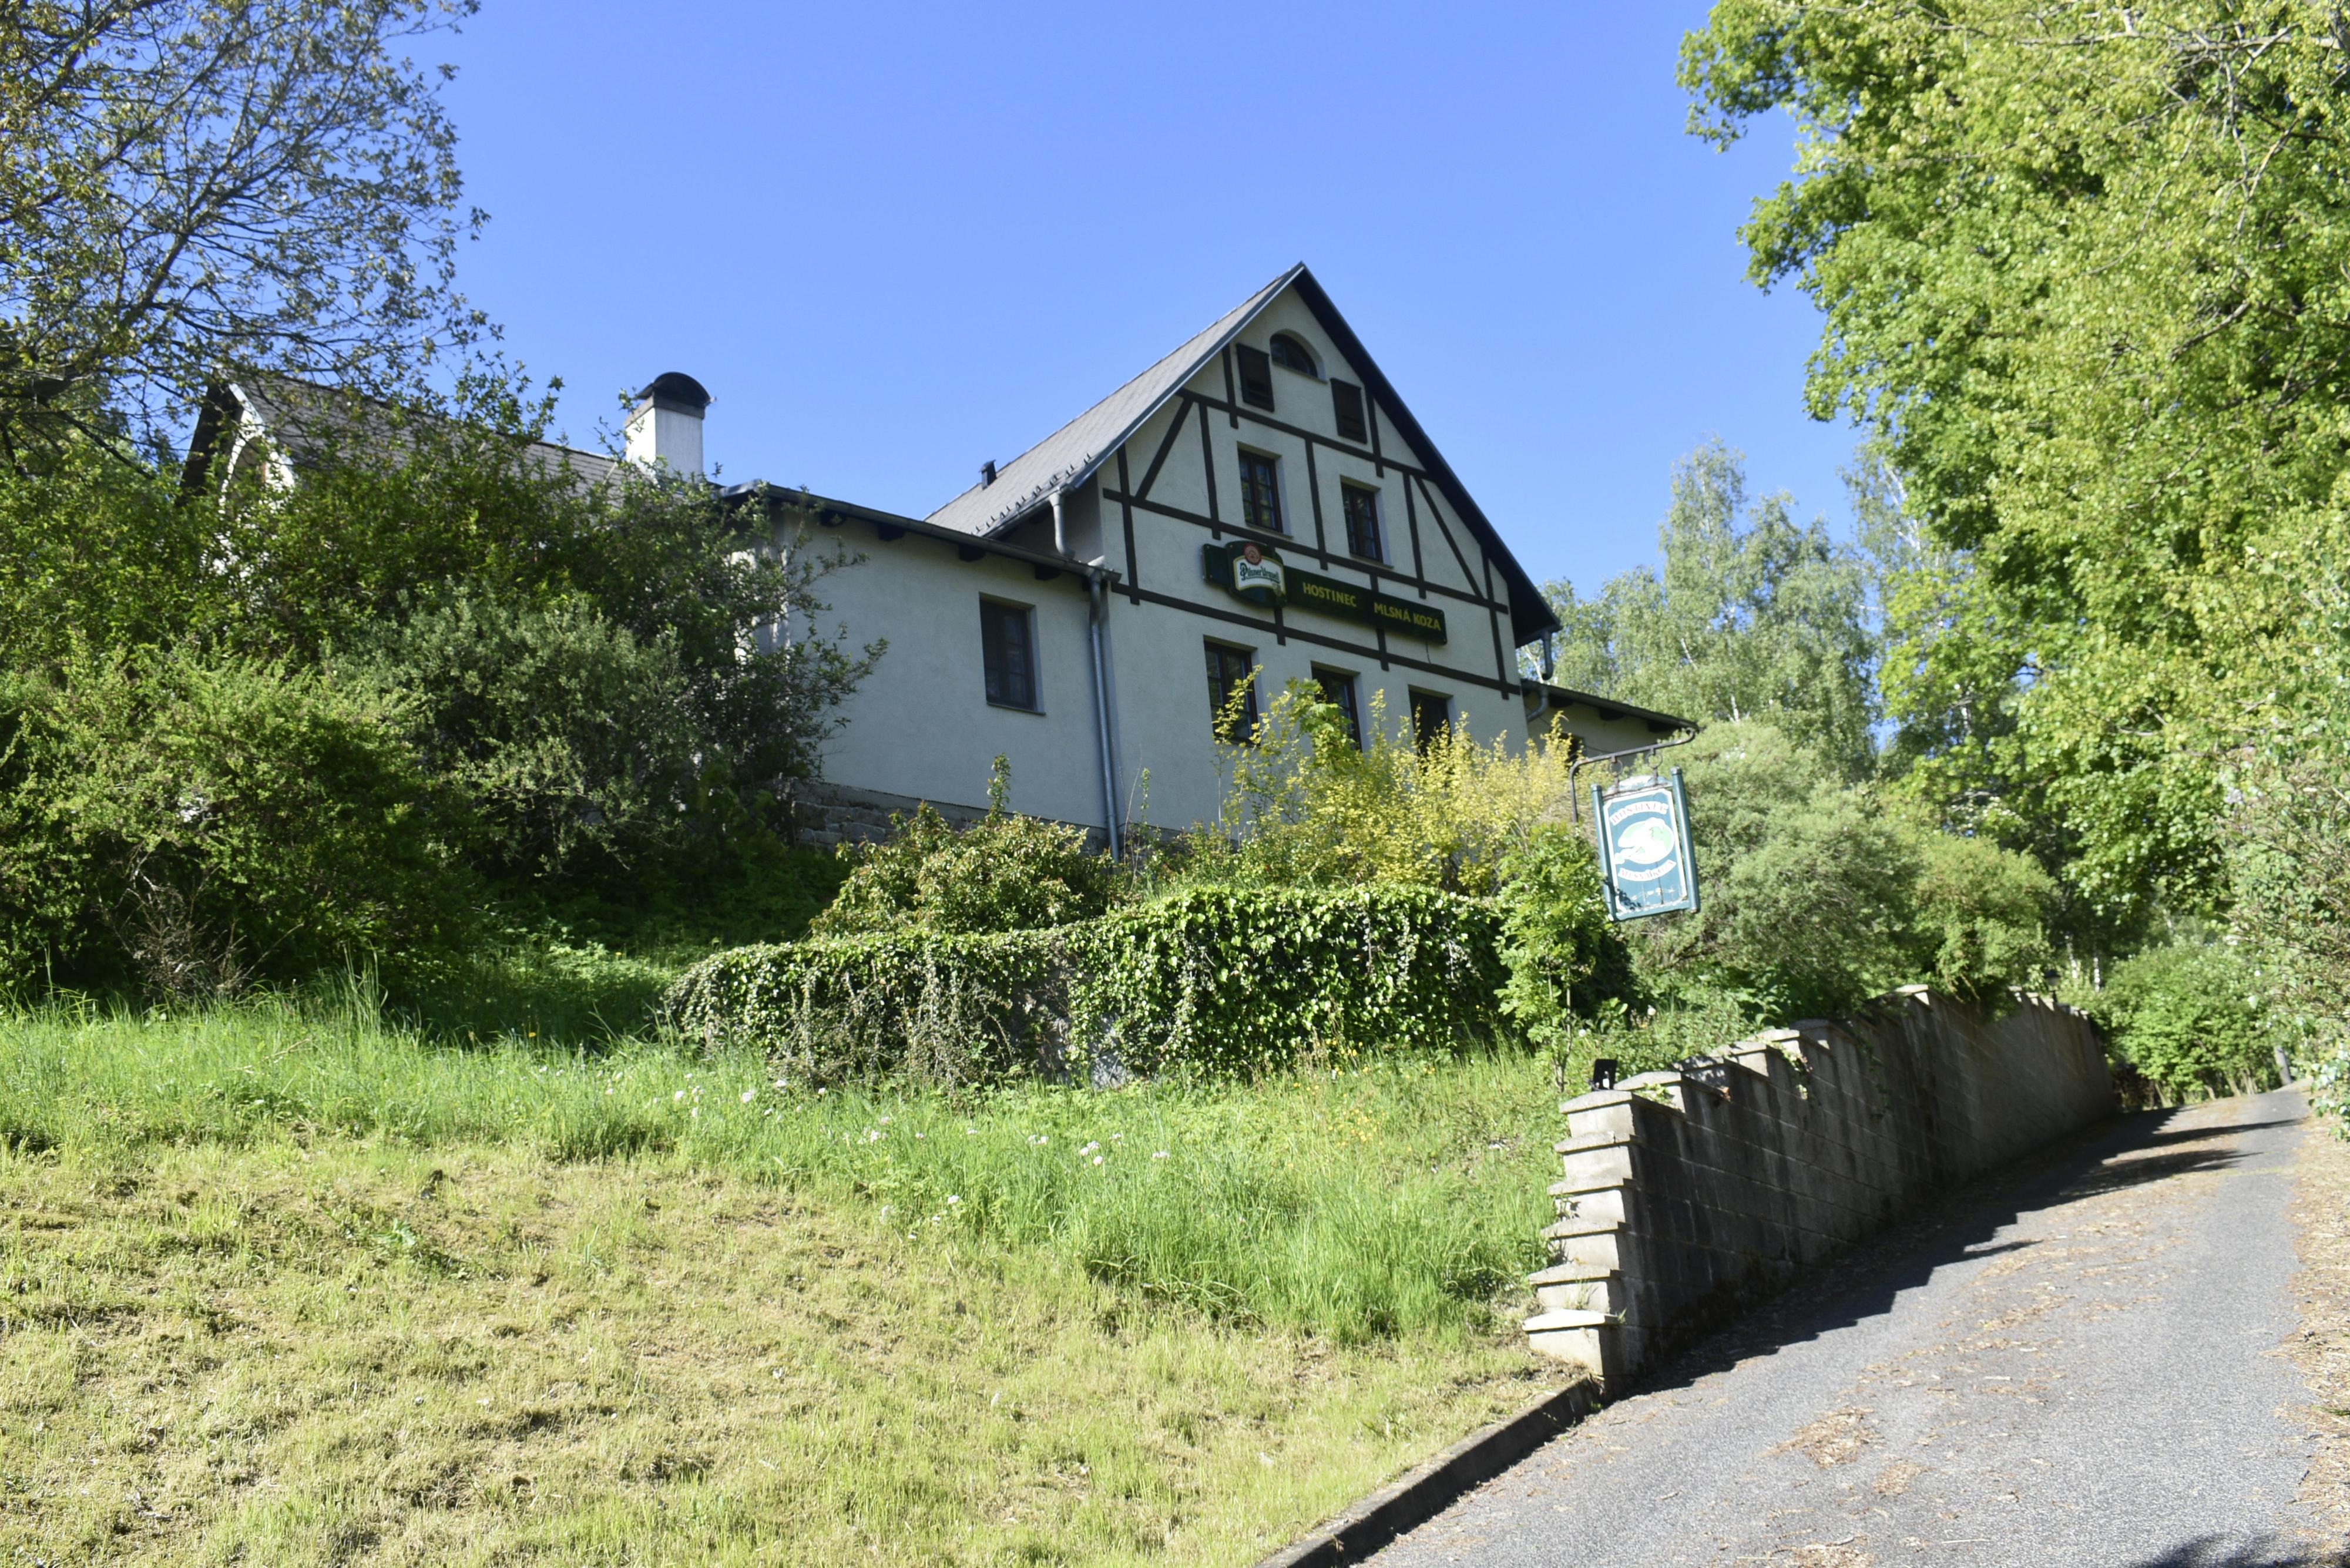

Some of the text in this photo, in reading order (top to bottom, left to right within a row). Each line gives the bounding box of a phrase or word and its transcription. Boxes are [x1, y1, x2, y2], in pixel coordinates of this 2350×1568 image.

[1240, 562, 1280, 582] Pilsner Urquell
[1302, 582, 1442, 630] HOSTINEC MLSNÁ KOZA
